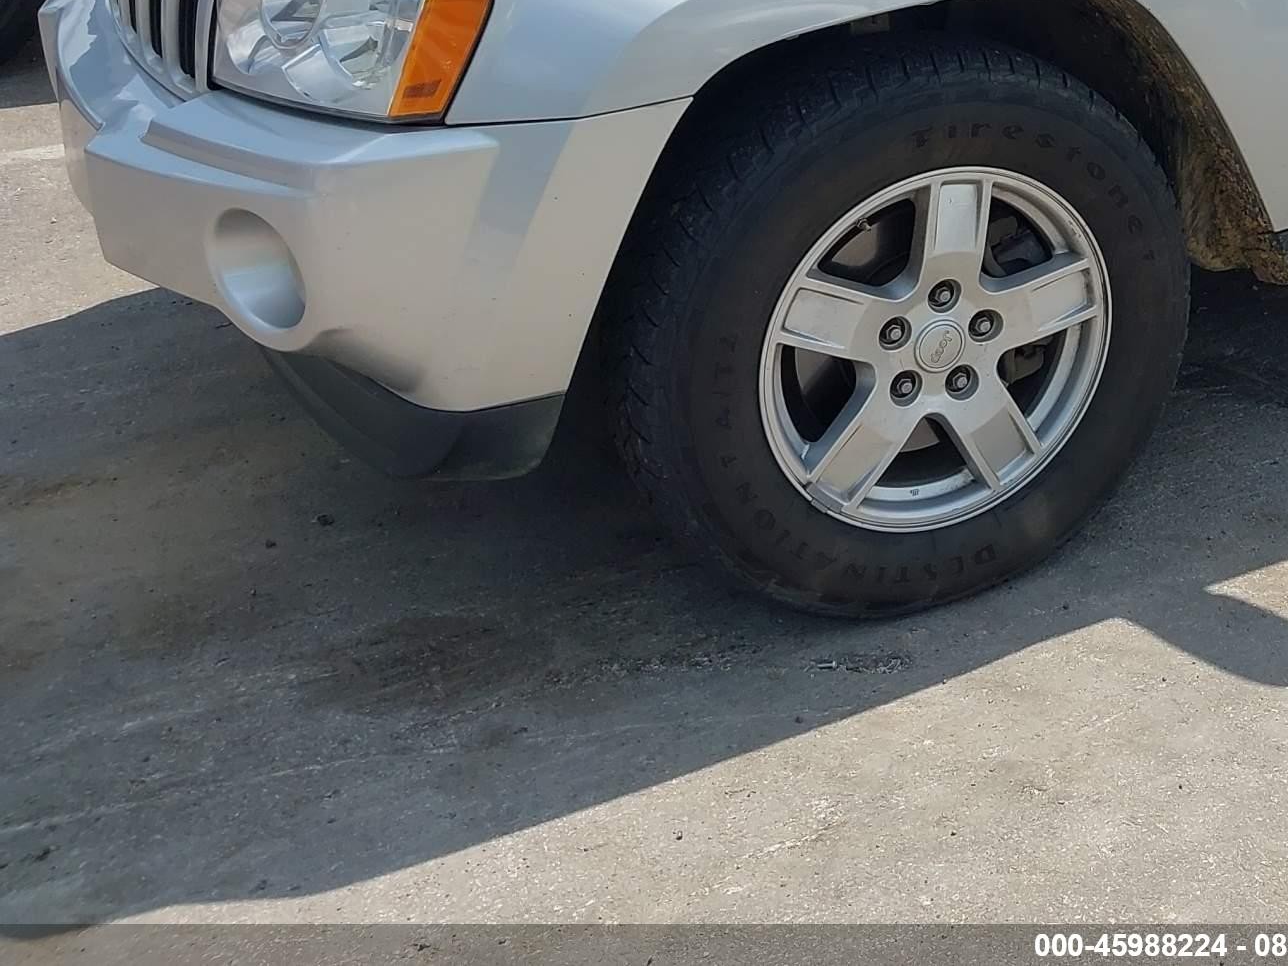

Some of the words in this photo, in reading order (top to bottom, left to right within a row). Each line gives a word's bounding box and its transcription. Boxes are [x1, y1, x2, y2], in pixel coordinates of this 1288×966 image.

[911, 121, 1144, 234] Firestone
[930, 330, 953, 363] Jeep
[736, 481, 998, 584] DESTINATION
